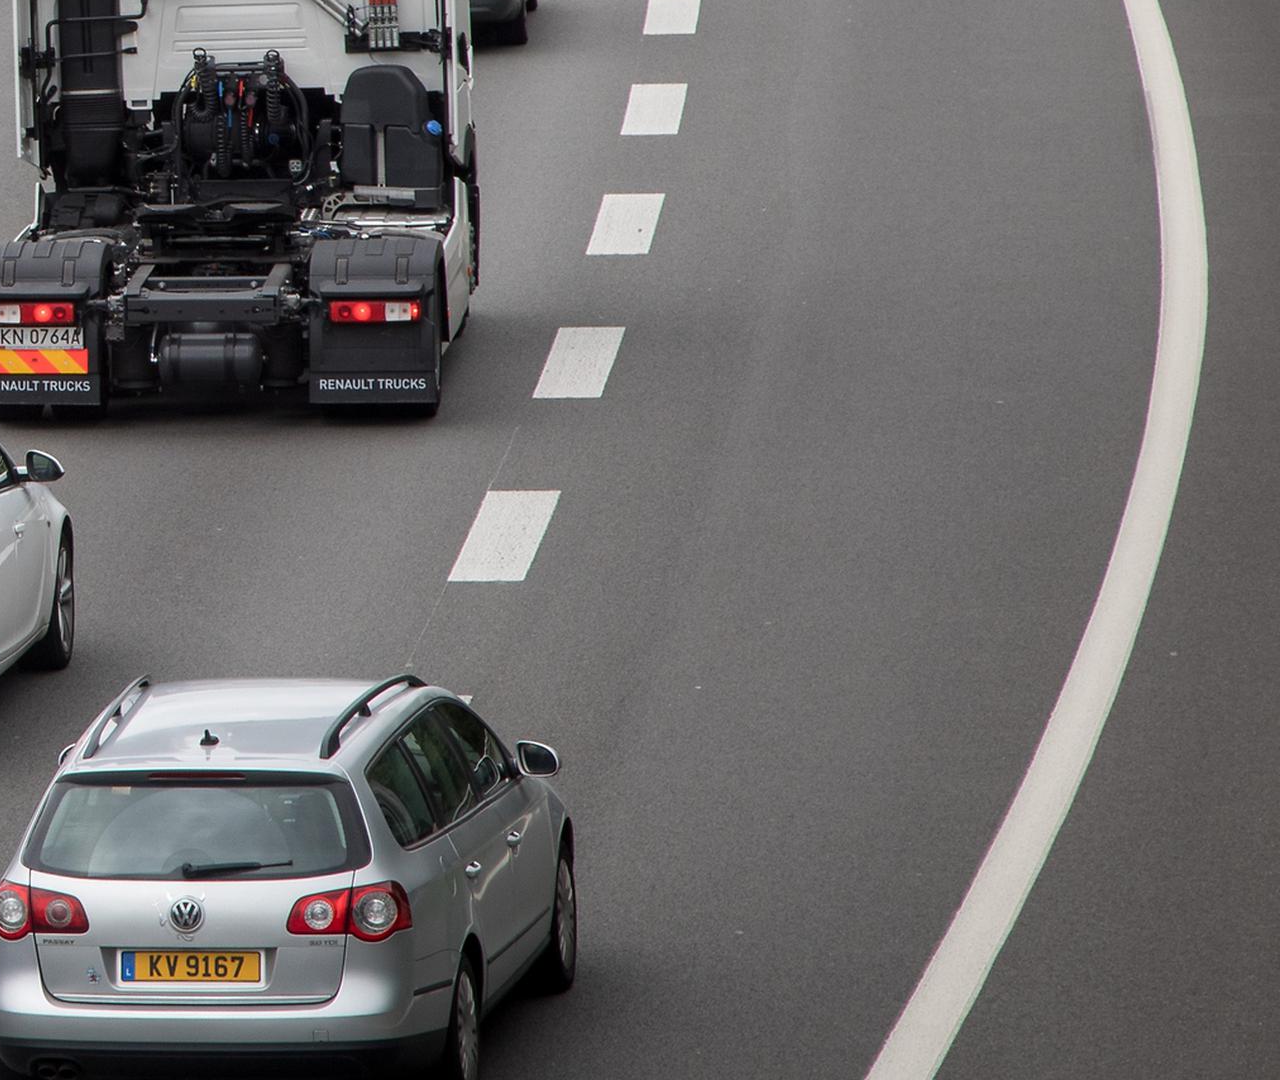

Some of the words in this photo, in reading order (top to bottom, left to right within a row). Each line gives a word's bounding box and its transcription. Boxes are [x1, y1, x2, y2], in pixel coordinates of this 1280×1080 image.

[1, 329, 24, 345] KN
[30, 328, 80, 344] 0764A
[42, 380, 91, 392] TRUCKS
[320, 379, 375, 390] RENAULT
[377, 379, 427, 390] TRUCKS
[149, 954, 179, 977] KV
[186, 955, 245, 978] 9167
